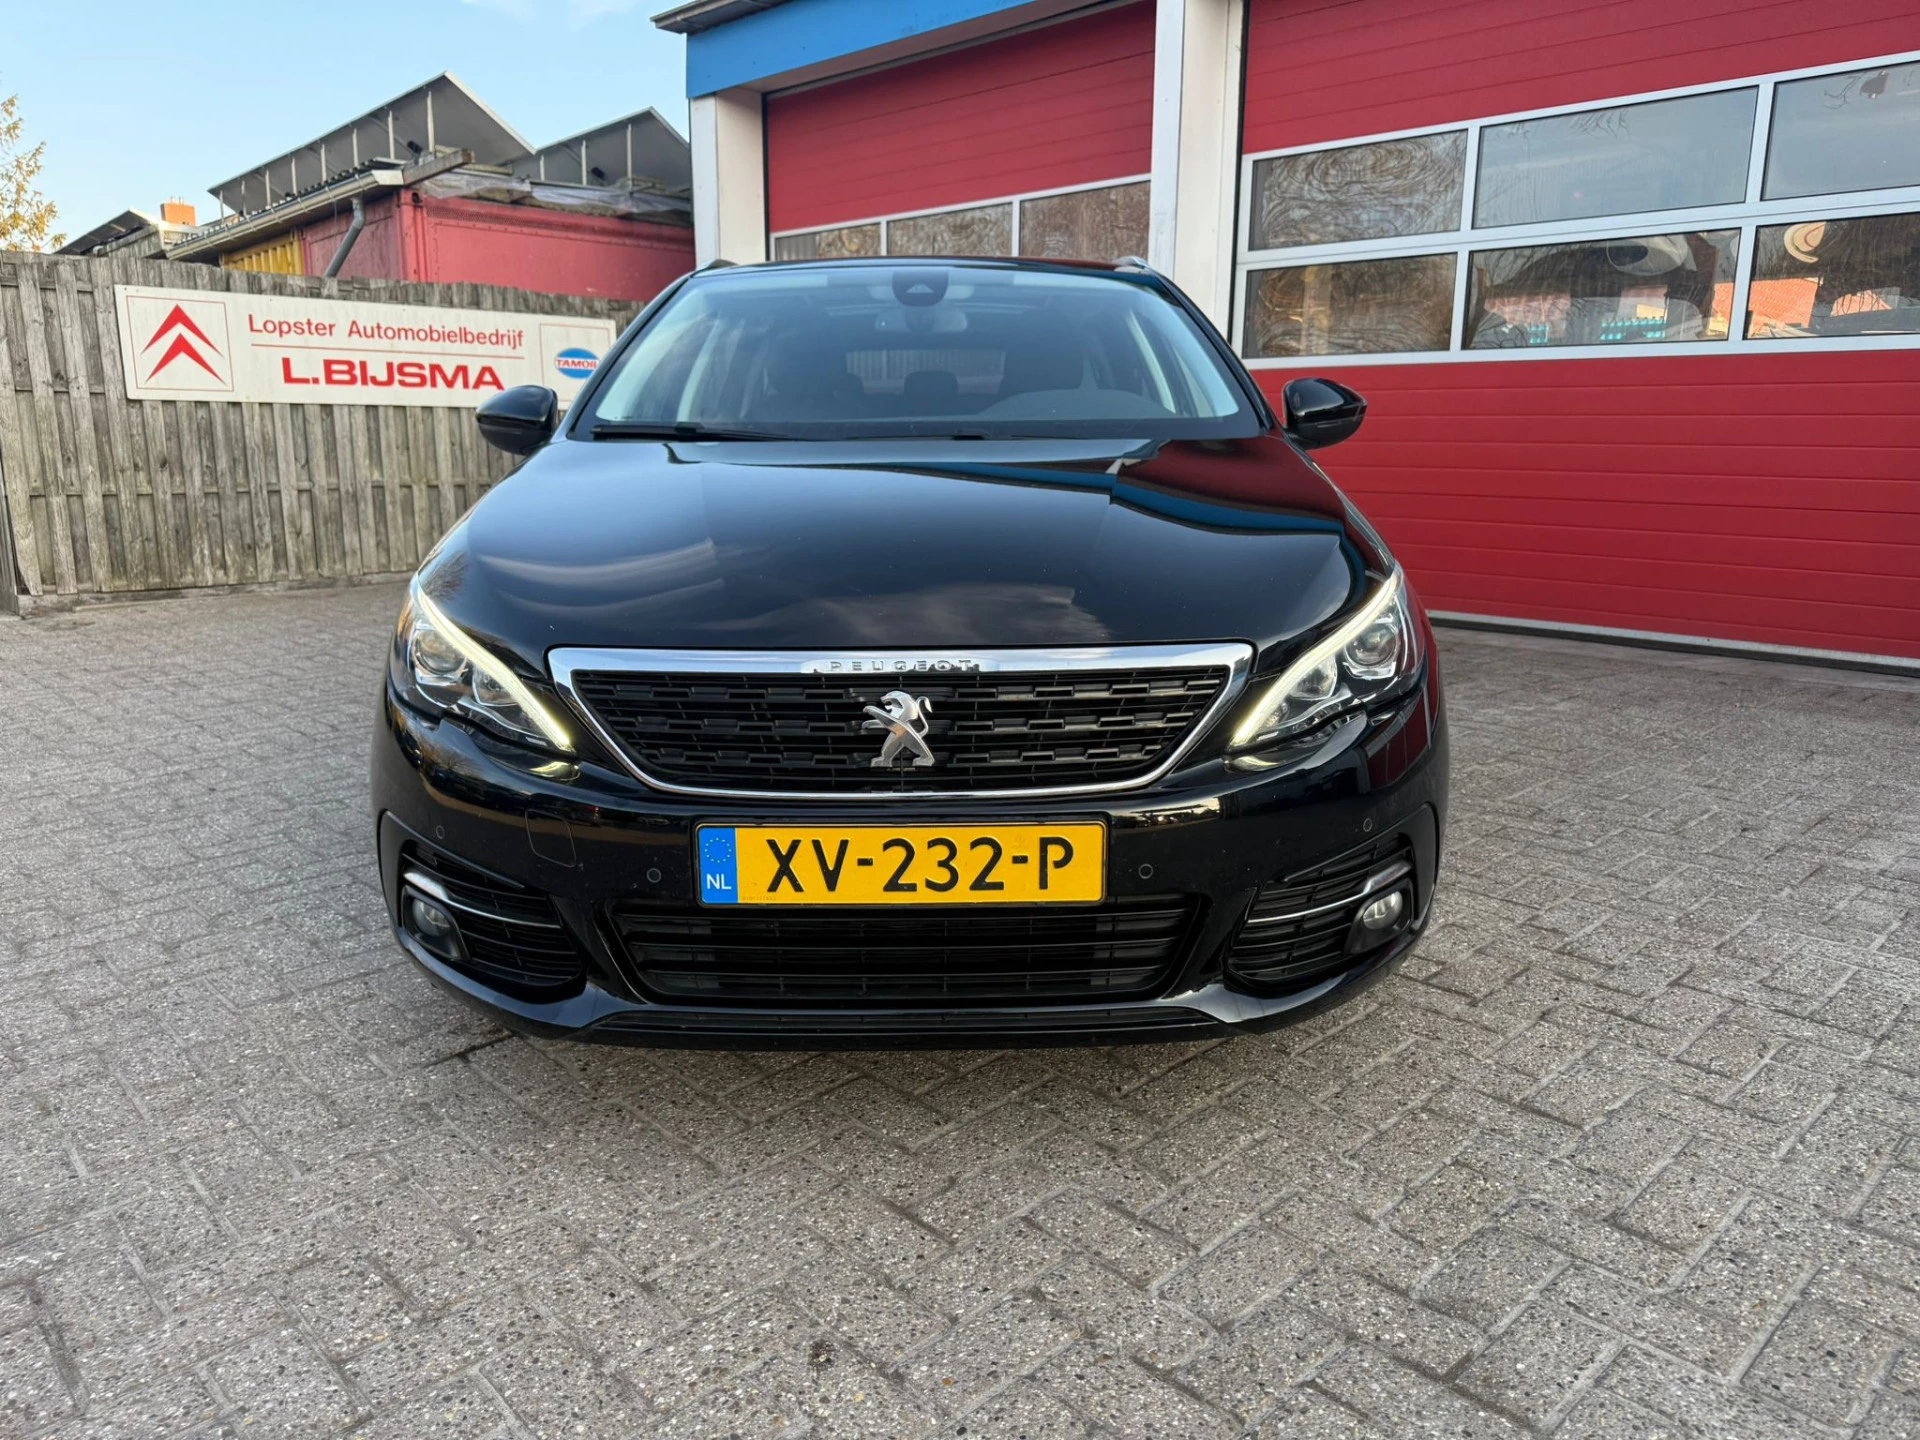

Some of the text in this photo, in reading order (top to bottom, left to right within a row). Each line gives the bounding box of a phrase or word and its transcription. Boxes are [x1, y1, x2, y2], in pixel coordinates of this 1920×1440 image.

[248, 314, 525, 350] Lopster Automobielbedrijf
[281, 357, 505, 390] L.BIJSMA
[830, 660, 971, 672] PEUGEOT
[765, 836, 1075, 893] XV-232-P
[706, 873, 732, 890] NL
